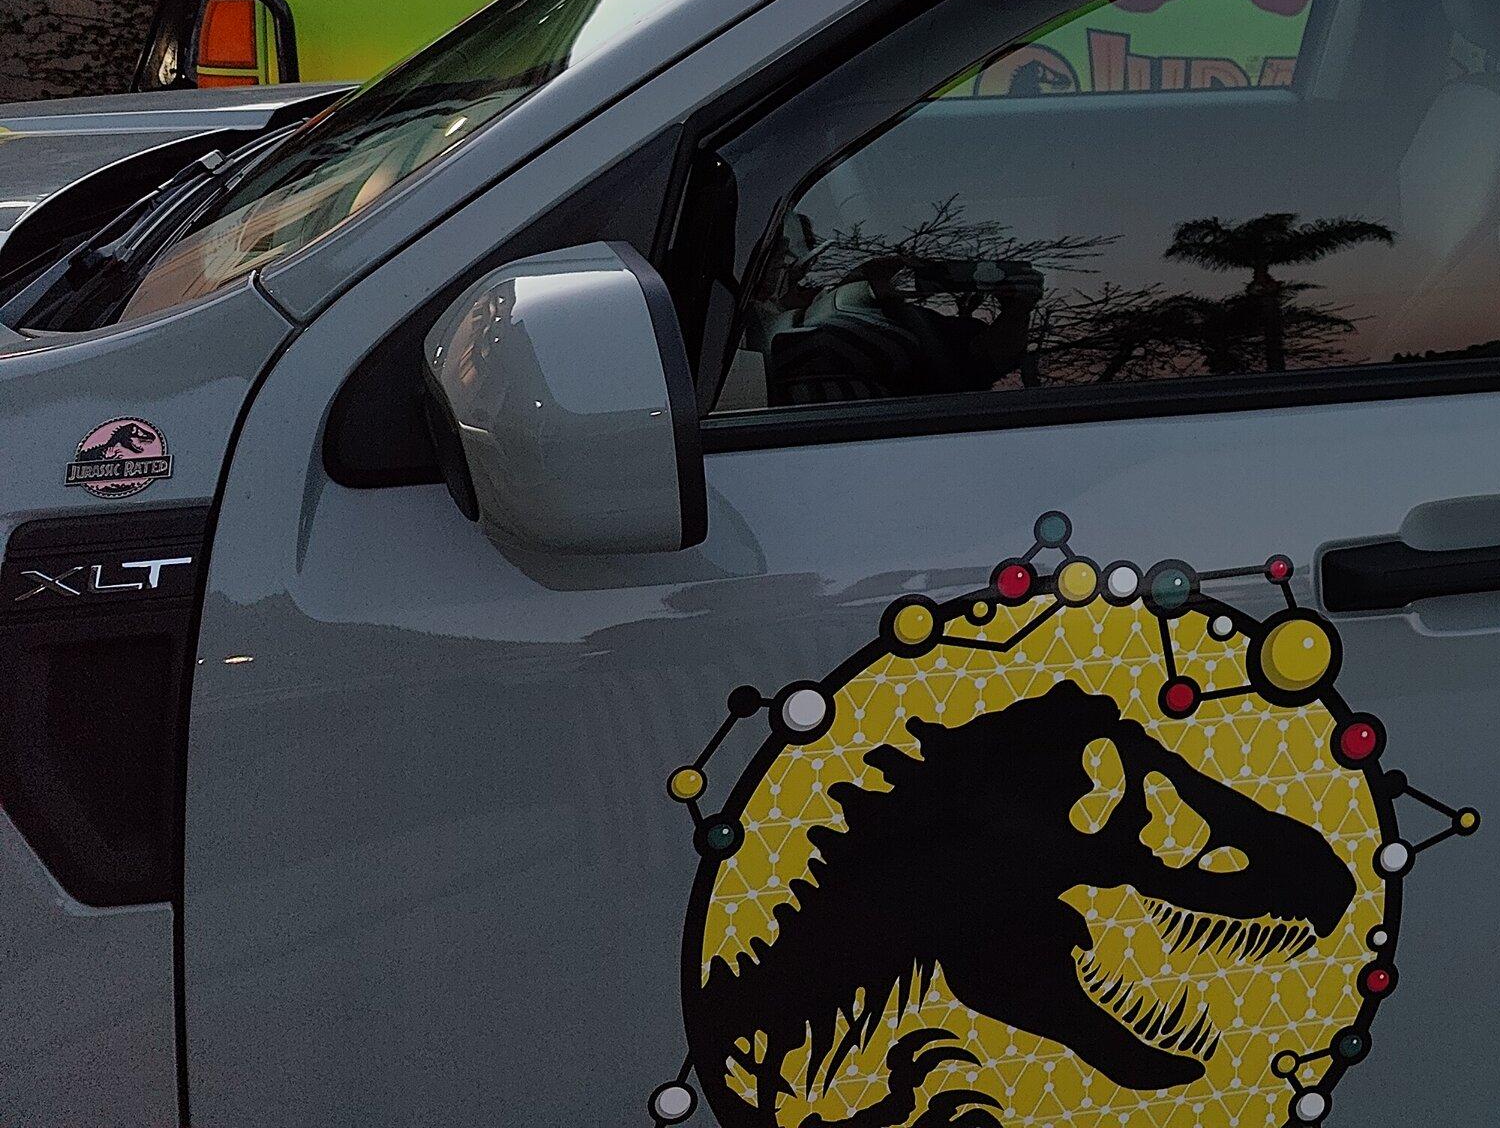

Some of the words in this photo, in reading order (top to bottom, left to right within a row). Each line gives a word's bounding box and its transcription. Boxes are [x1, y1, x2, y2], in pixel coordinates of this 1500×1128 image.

[68, 463, 120, 481] JURASSIC
[124, 460, 168, 476] RATED
[15, 557, 192, 601] XLT
